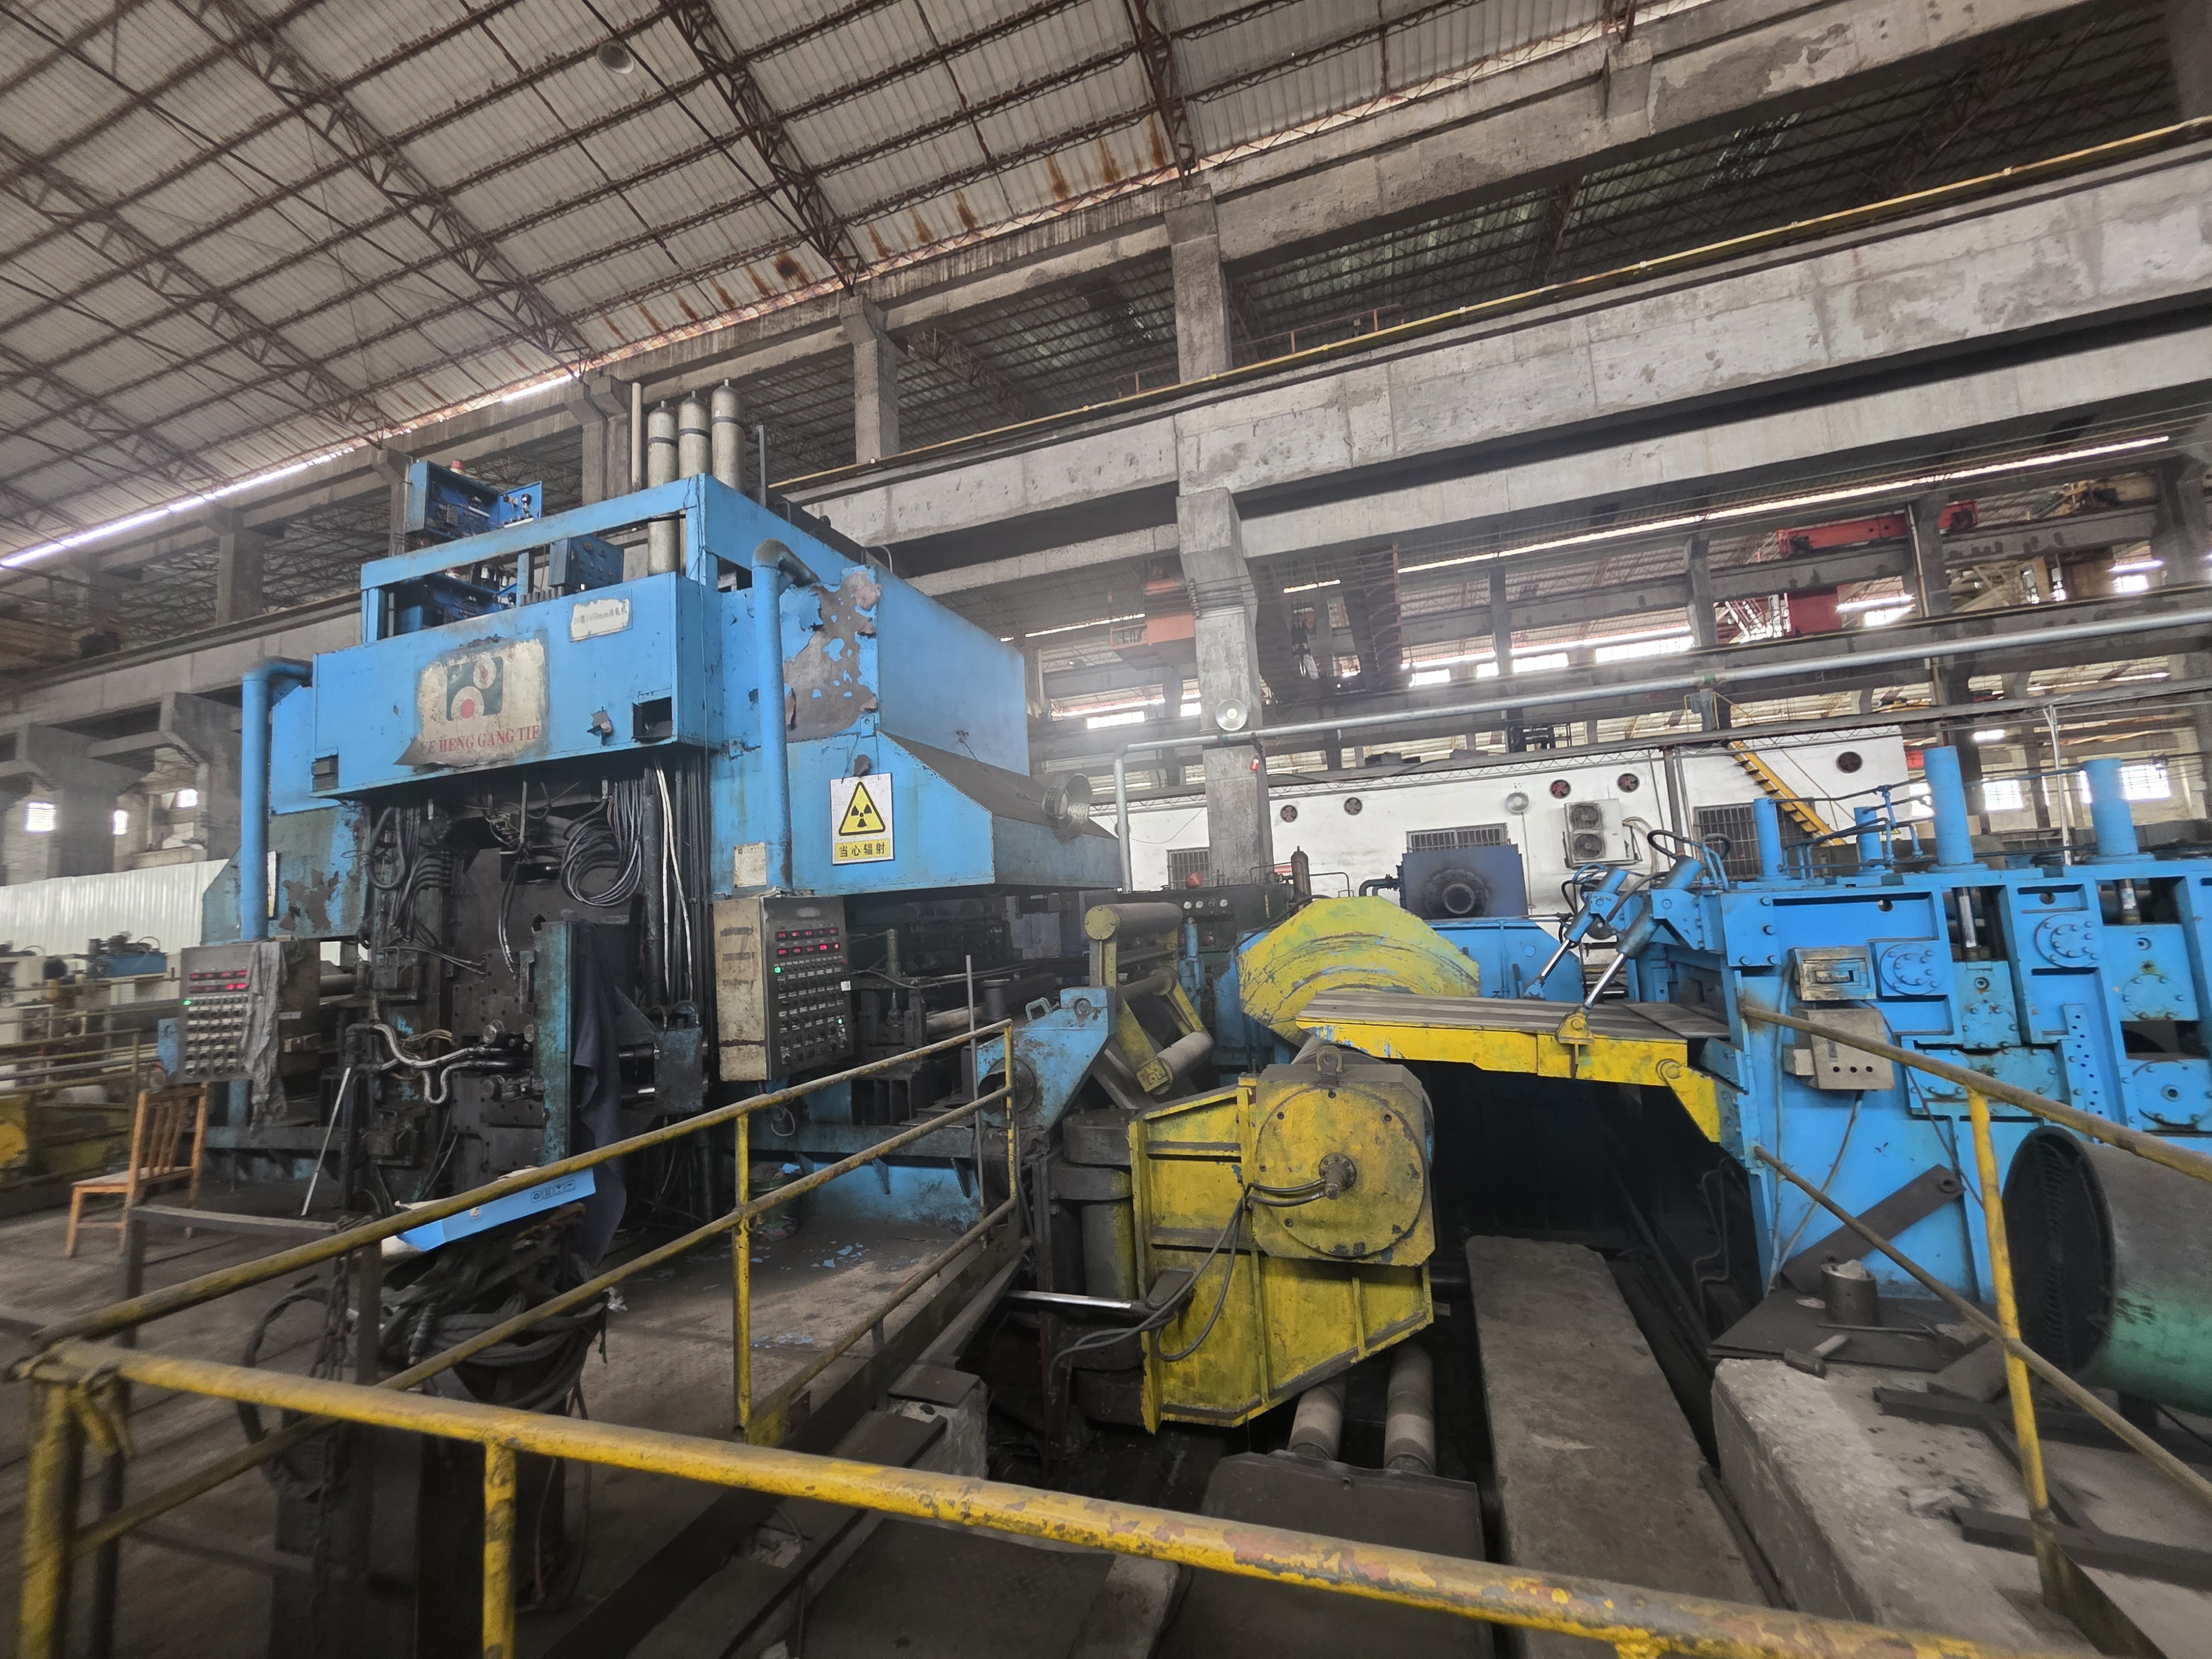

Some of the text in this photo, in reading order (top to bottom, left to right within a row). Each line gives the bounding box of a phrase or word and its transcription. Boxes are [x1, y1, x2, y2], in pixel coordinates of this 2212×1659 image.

[439, 735, 475, 752] HENG
[477, 729, 514, 747] GANG
[517, 725, 540, 741] TIE
[839, 842, 885, 857] 当心辐射
